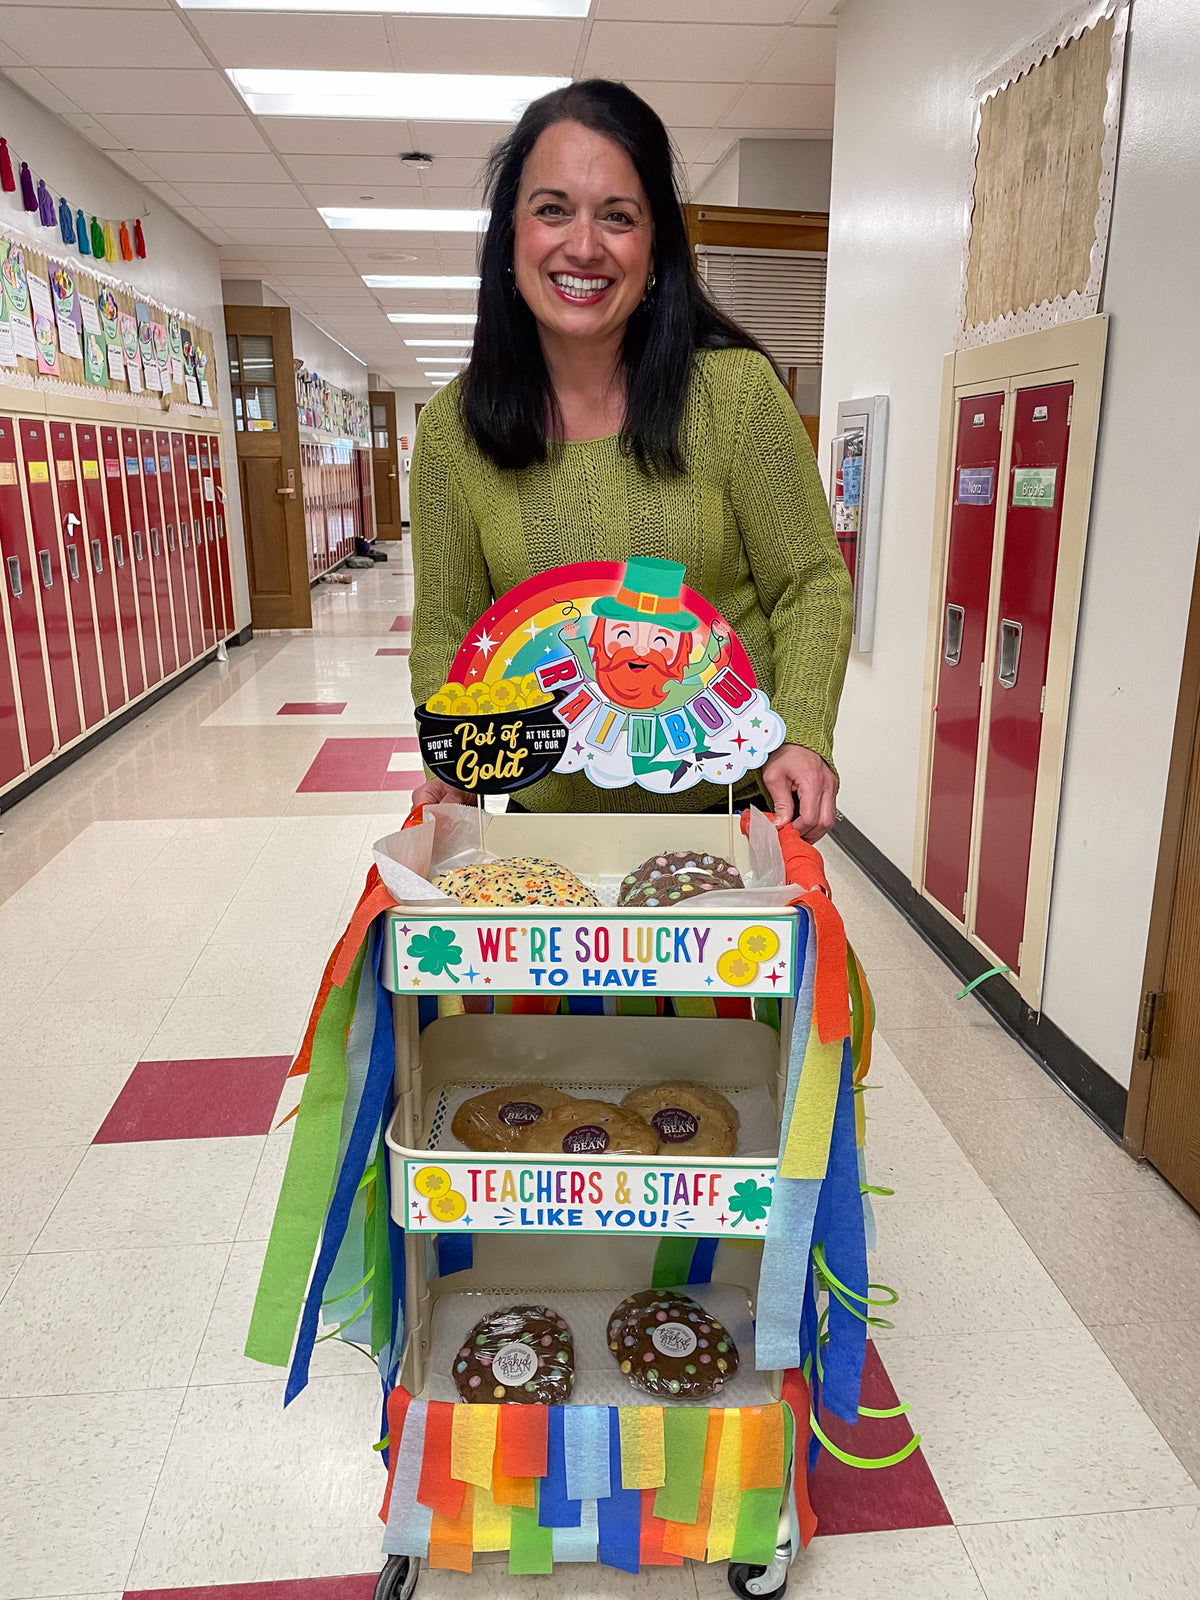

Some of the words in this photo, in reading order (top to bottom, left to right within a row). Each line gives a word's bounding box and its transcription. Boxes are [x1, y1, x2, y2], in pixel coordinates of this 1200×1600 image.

[538, 659, 753, 754] RAINBOW
[453, 721, 496, 751] Pot
[500, 720, 524, 749] of
[526, 730, 536, 740] AT
[537, 729, 551, 739] THE
[552, 728, 566, 739] END
[427, 738, 453, 751] YOU'RE
[534, 741, 543, 750] OF
[544, 740, 559, 749] OUR
[434, 750, 448, 760] THE
[456, 747, 528, 789] Gold
[477, 926, 562, 963] WE'RE
[575, 927, 609, 963] SO
[622, 927, 712, 964] LUCKY
[529, 968, 568, 986] TO
[582, 968, 658, 987] HAVE
[507, 1112, 539, 1121] BEAN
[661, 1123, 695, 1134] BEAN
[572, 1139, 606, 1152] BEAN
[467, 1169, 603, 1204] TEACHERS
[614, 1172, 631, 1204] &
[643, 1172, 722, 1206] STAFF
[520, 1208, 583, 1226] LIKE
[594, 1209, 670, 1228] YOU!
